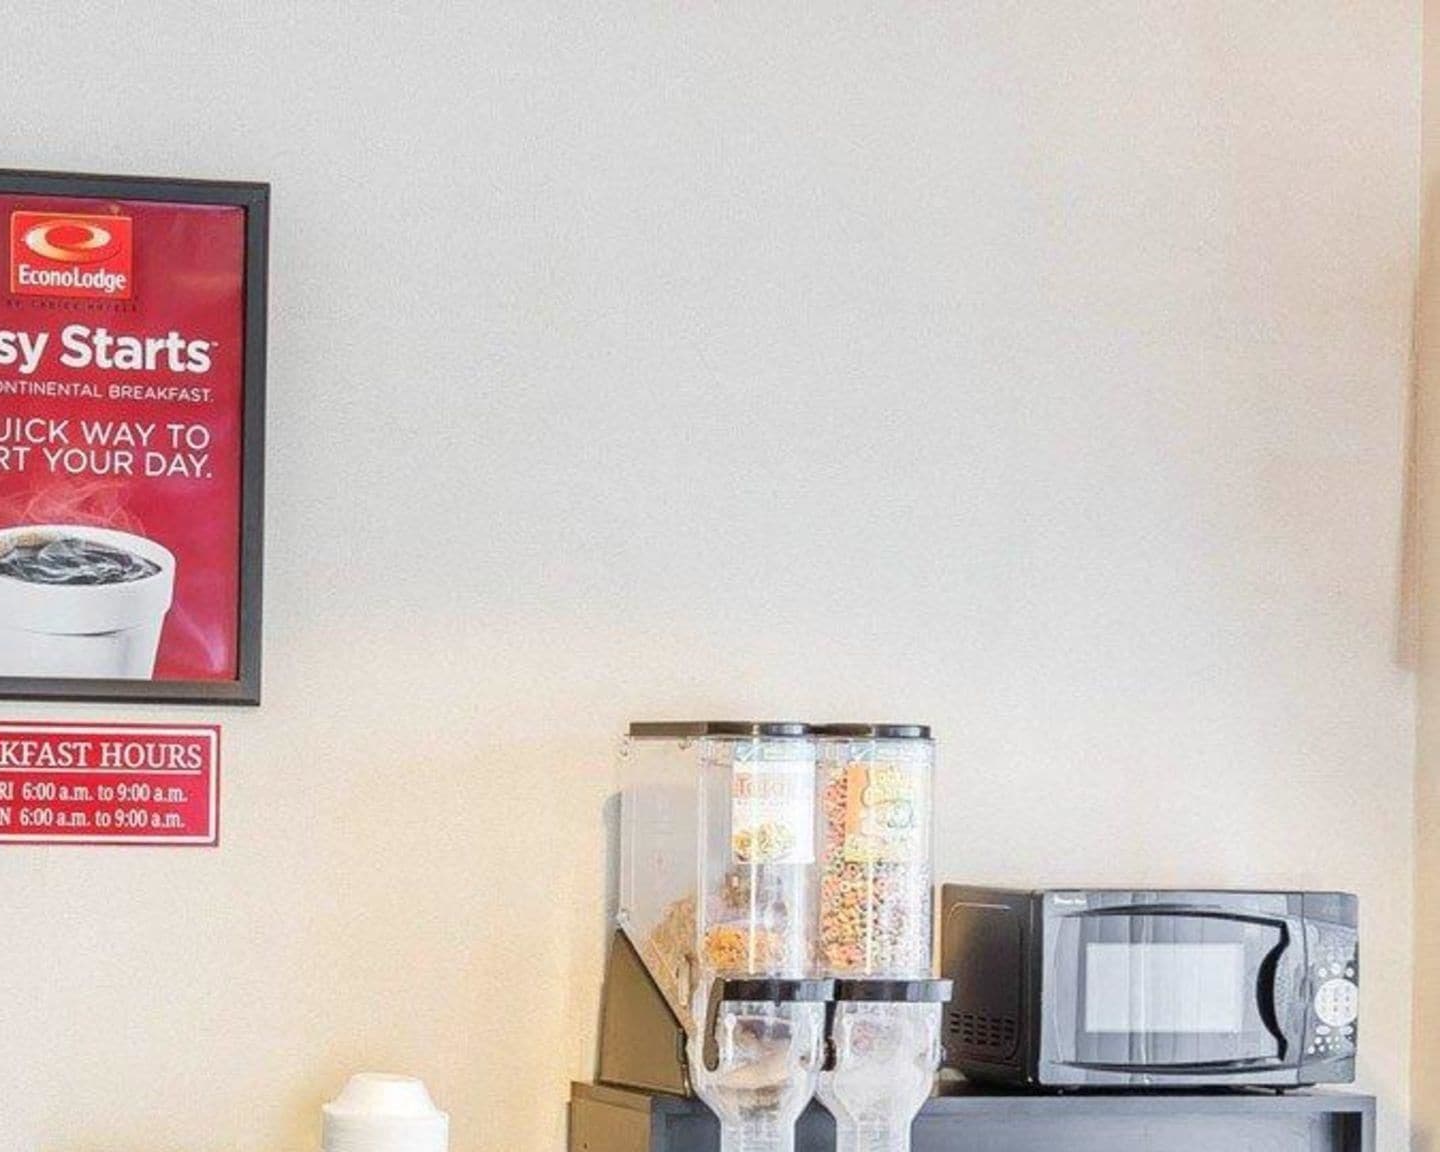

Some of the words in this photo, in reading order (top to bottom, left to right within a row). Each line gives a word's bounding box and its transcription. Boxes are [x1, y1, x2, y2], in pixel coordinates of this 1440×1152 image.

[18, 265, 127, 292] EconoLodge
[60, 325, 212, 373] Starts
[109, 386, 214, 402] BREAKFAST.
[80, 421, 156, 446] WAY
[167, 425, 210, 450] TO
[41, 449, 134, 475] YOUR
[145, 454, 213, 478] DAY.
[99, 743, 202, 769] HOURS
[22, 783, 56, 801] 6:00
[59, 786, 92, 801] a.m.
[98, 784, 114, 801] to
[117, 783, 150, 801] 9:00
[153, 786, 188, 802] a.m.
[19, 809, 53, 826] 6:00
[56, 812, 91, 826] a.m.
[95, 810, 111, 826] to
[114, 809, 147, 827] 9:00
[151, 812, 185, 827] a.m.
